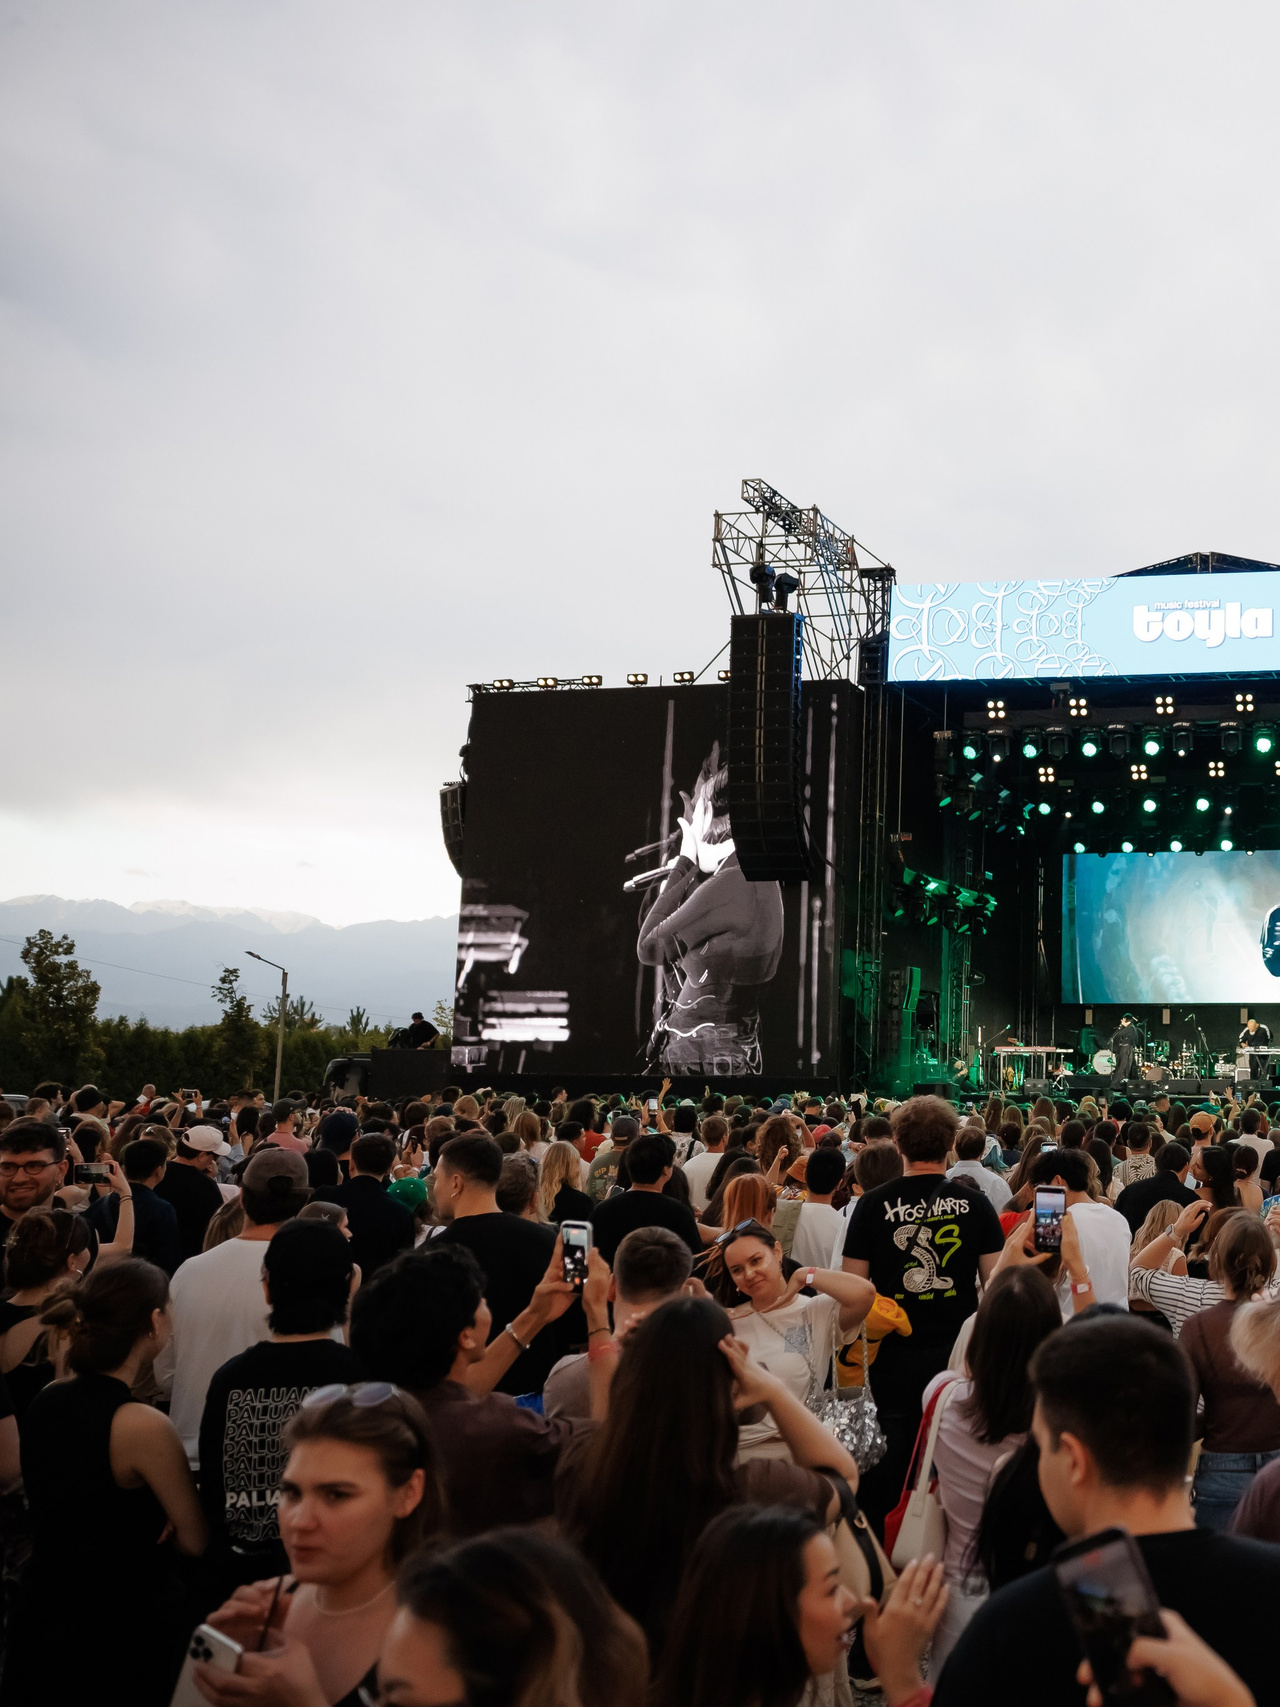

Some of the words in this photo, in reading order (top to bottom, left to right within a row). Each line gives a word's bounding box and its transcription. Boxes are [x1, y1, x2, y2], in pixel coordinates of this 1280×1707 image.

[1154, 601, 1183, 610] music
[1184, 599, 1221, 609] festival
[1133, 602, 1273, 648] toyla
[884, 1197, 969, 1222] HOGWARTS
[224, 1421, 282, 1441] PALU
[223, 1438, 285, 1458] PALU
[223, 1455, 287, 1475] PALU
[223, 1472, 281, 1491] PALU
